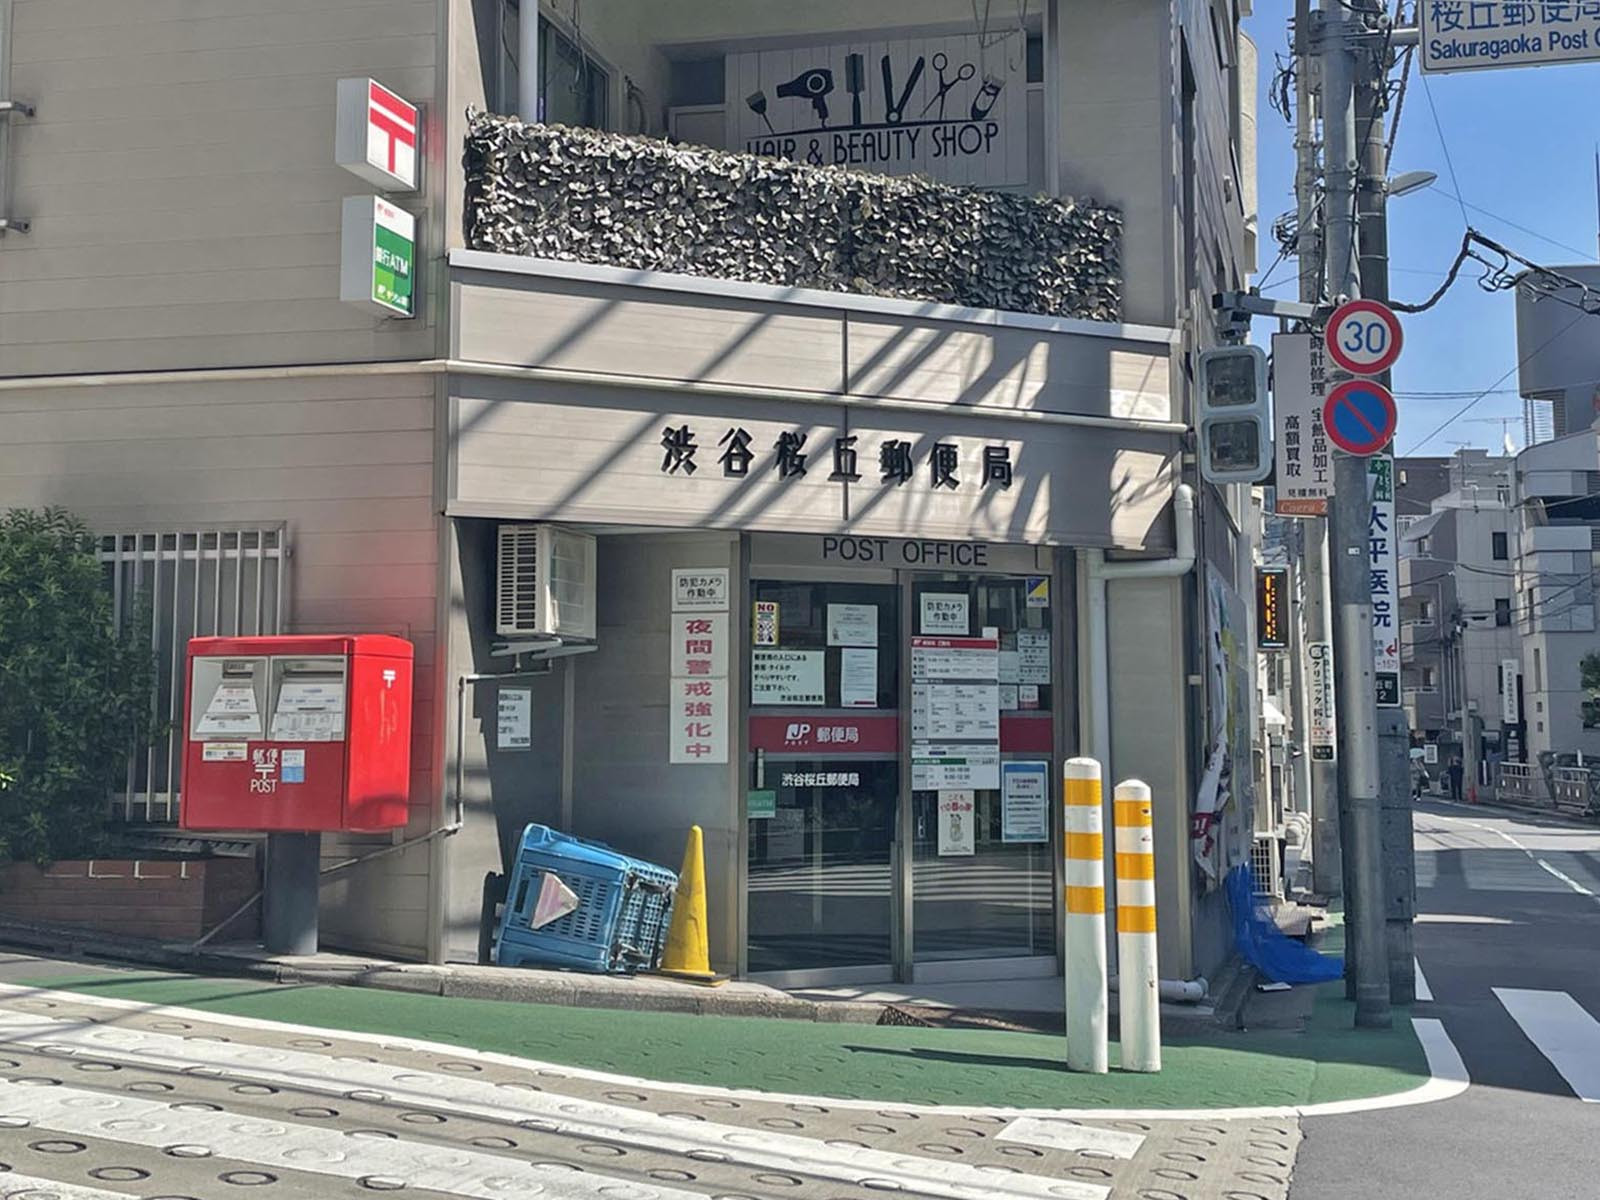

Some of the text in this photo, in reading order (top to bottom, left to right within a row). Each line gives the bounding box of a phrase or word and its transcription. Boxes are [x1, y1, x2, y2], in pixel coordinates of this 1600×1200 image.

[1430, 34, 1542, 60] Sakuragaoka
[1549, 29, 1588, 51] Post
[807, 139, 824, 165] &
[834, 129, 920, 164] BEAUTY
[932, 122, 998, 157] SHOP
[1345, 321, 1385, 354] 30
[660, 424, 1014, 491] 渋谷桜丘郵便局
[1285, 415, 1301, 477] 高額買取
[823, 536, 988, 567] POST OFFICE
[680, 577, 722, 588] 防犯カメラ
[687, 588, 716, 598] 作動中
[757, 603, 774, 611] NO
[685, 618, 713, 759] 夜間警戒強化中
[816, 726, 859, 743] 郵便局
[250, 778, 277, 793] POST
[781, 772, 860, 787] 渋谷桜丘郵便局
